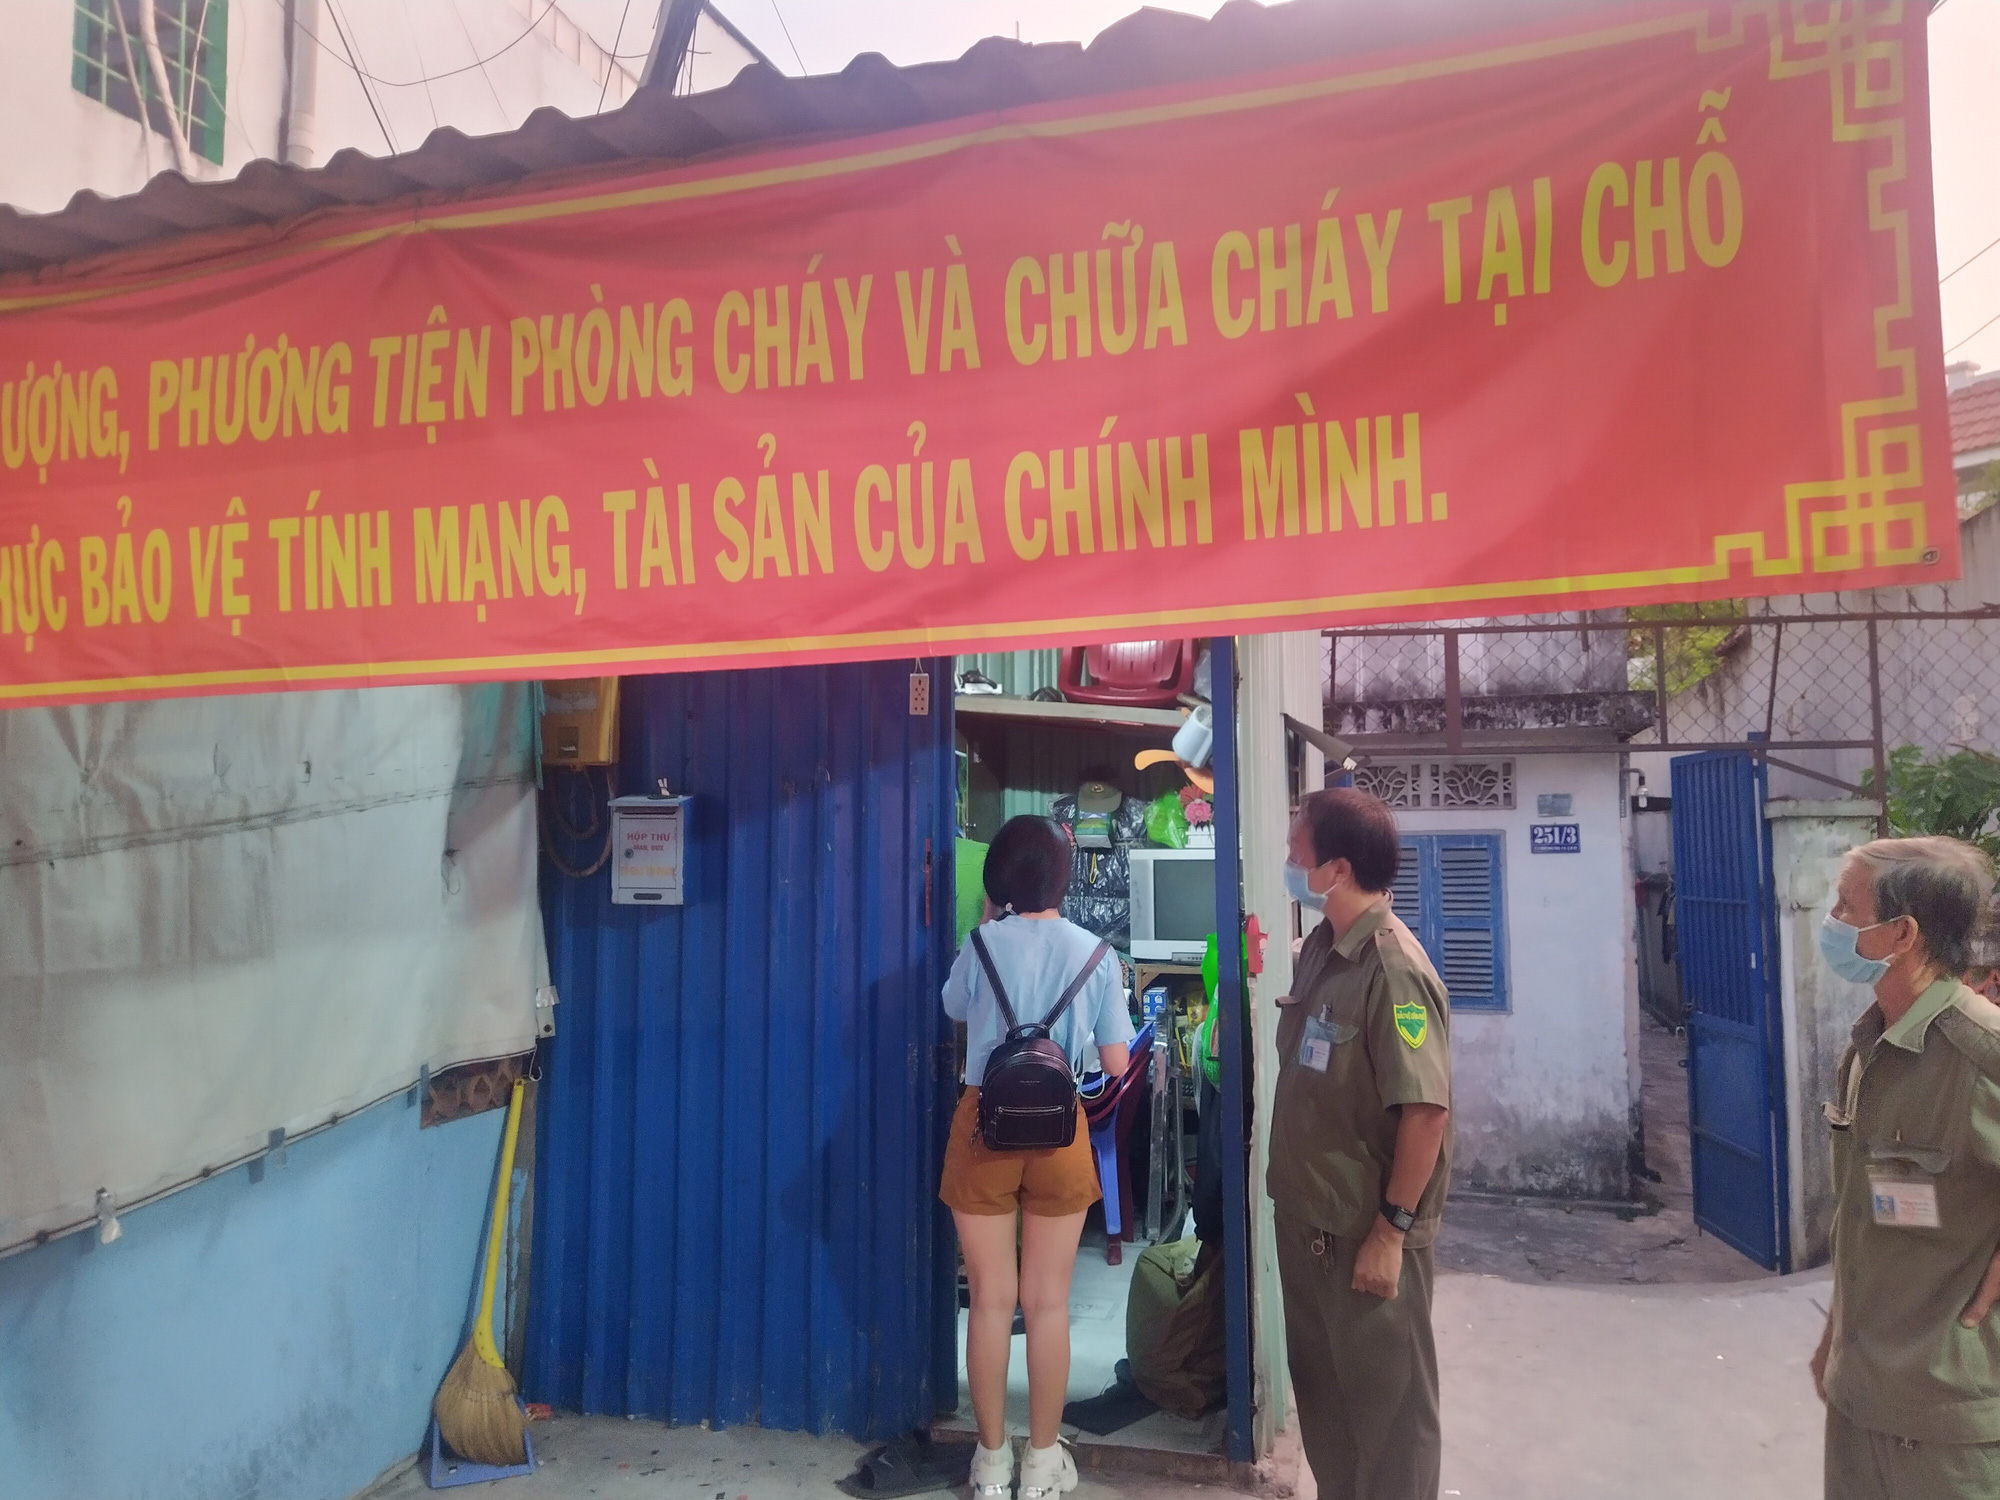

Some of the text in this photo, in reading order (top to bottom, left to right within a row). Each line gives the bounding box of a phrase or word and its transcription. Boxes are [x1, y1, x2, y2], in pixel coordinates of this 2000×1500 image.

[148, 333, 352, 450] PHƯƠNG
[369, 305, 490, 443] TIỆN
[511, 285, 692, 415] PHÒNG
[714, 259, 871, 393] CHÁY
[897, 237, 979, 374] VÀ
[1006, 222, 1187, 364] CHỮA
[1212, 190, 1401, 338] CHÁY
[1428, 177, 1553, 325] TẠI
[1581, 89, 1743, 287] CHỖ
[78, 495, 175, 629] BẢO
[188, 497, 253, 636] VỆ
[266, 489, 394, 613] TÍNH
[413, 496, 586, 621] MẠNG,
[604, 459, 694, 589] TÀI
[714, 434, 833, 581] SẢN
[855, 422, 983, 571] CỦA
[1005, 417, 1212, 559] CHÍNH
[1240, 393, 1447, 539] MÌNH.
[1533, 826, 1576, 844] 251/3
